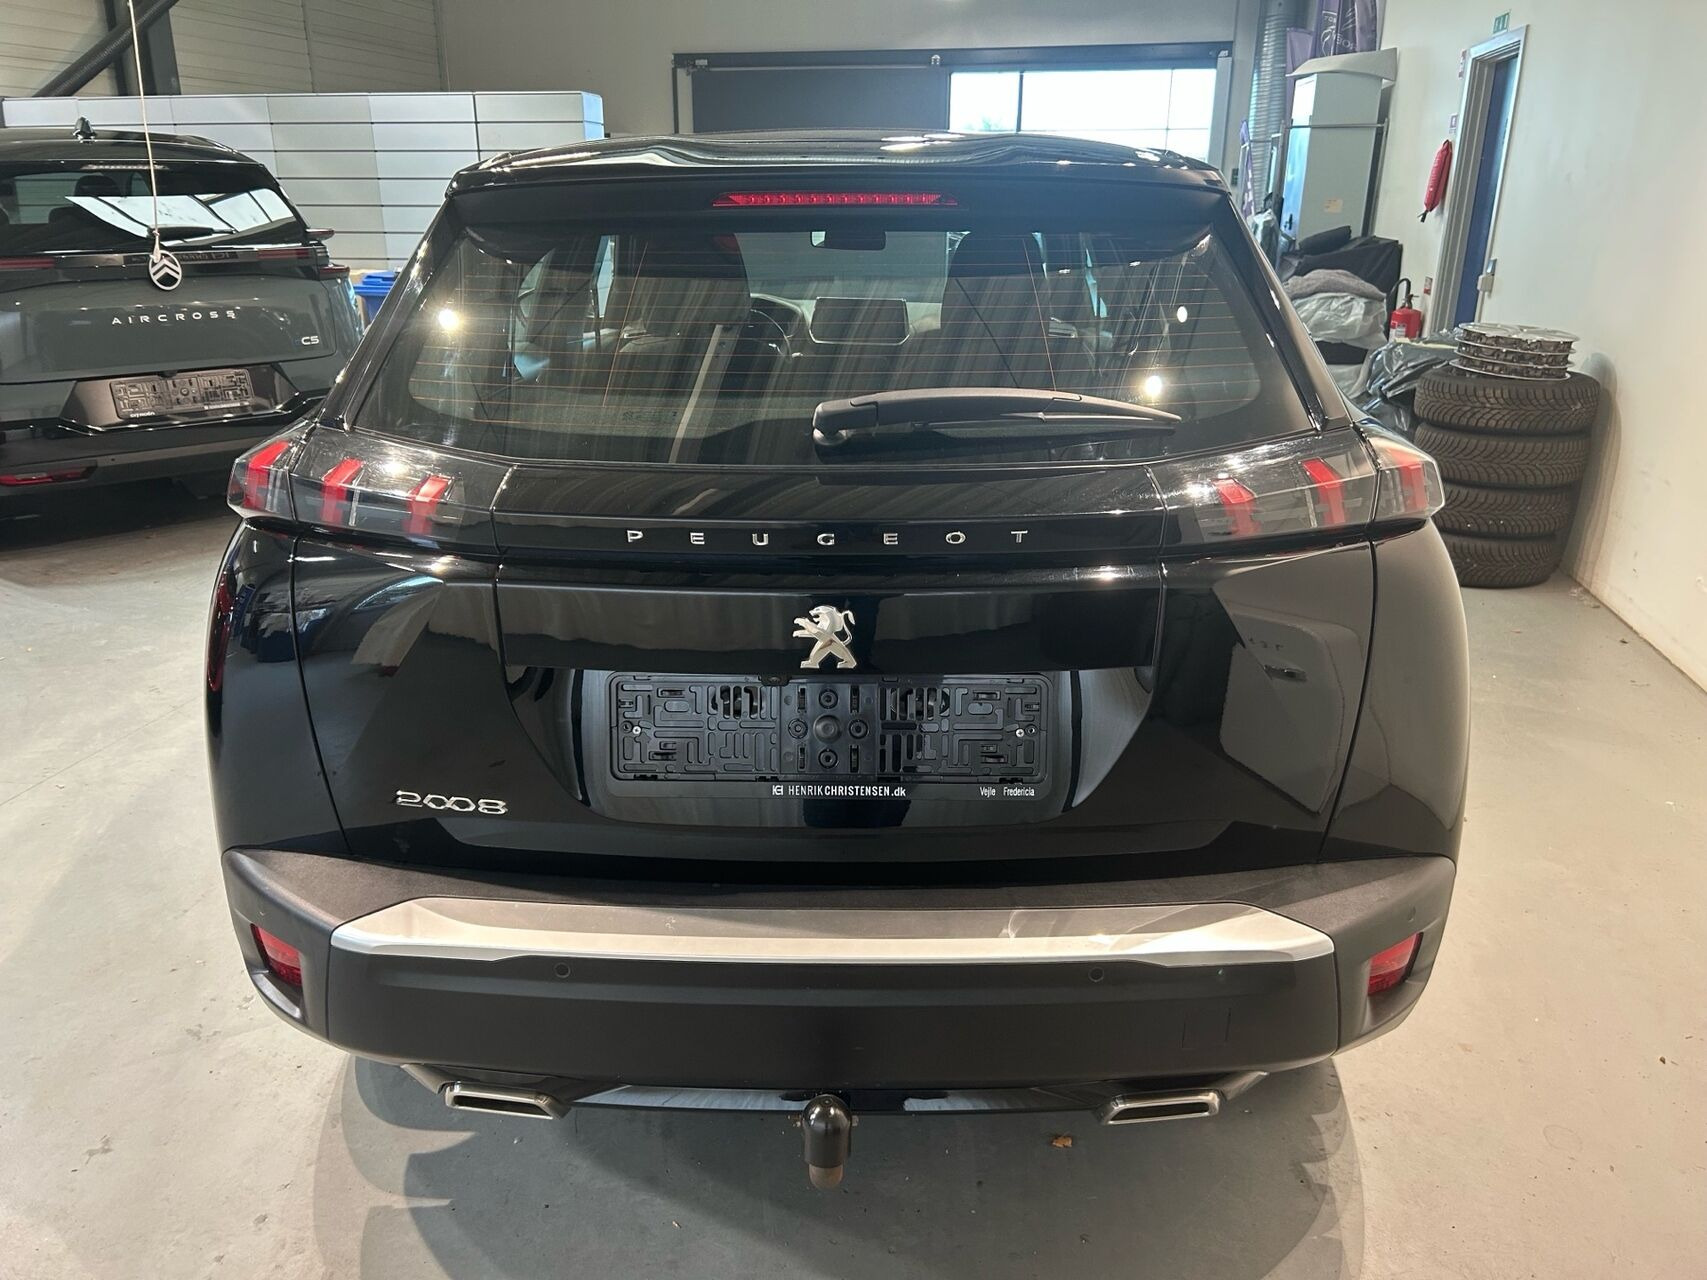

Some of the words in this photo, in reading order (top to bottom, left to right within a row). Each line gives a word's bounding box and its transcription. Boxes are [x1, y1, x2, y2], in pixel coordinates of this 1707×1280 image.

[111, 310, 236, 325] AIRCROSS
[301, 335, 320, 346] C5
[627, 529, 1029, 546] PEUGEOT
[788, 785, 906, 797] HENRIKCHRISTENSEN.dk
[979, 786, 996, 798] Vejle
[1003, 786, 1035, 797] Fredericia
[396, 790, 508, 815] 2008
